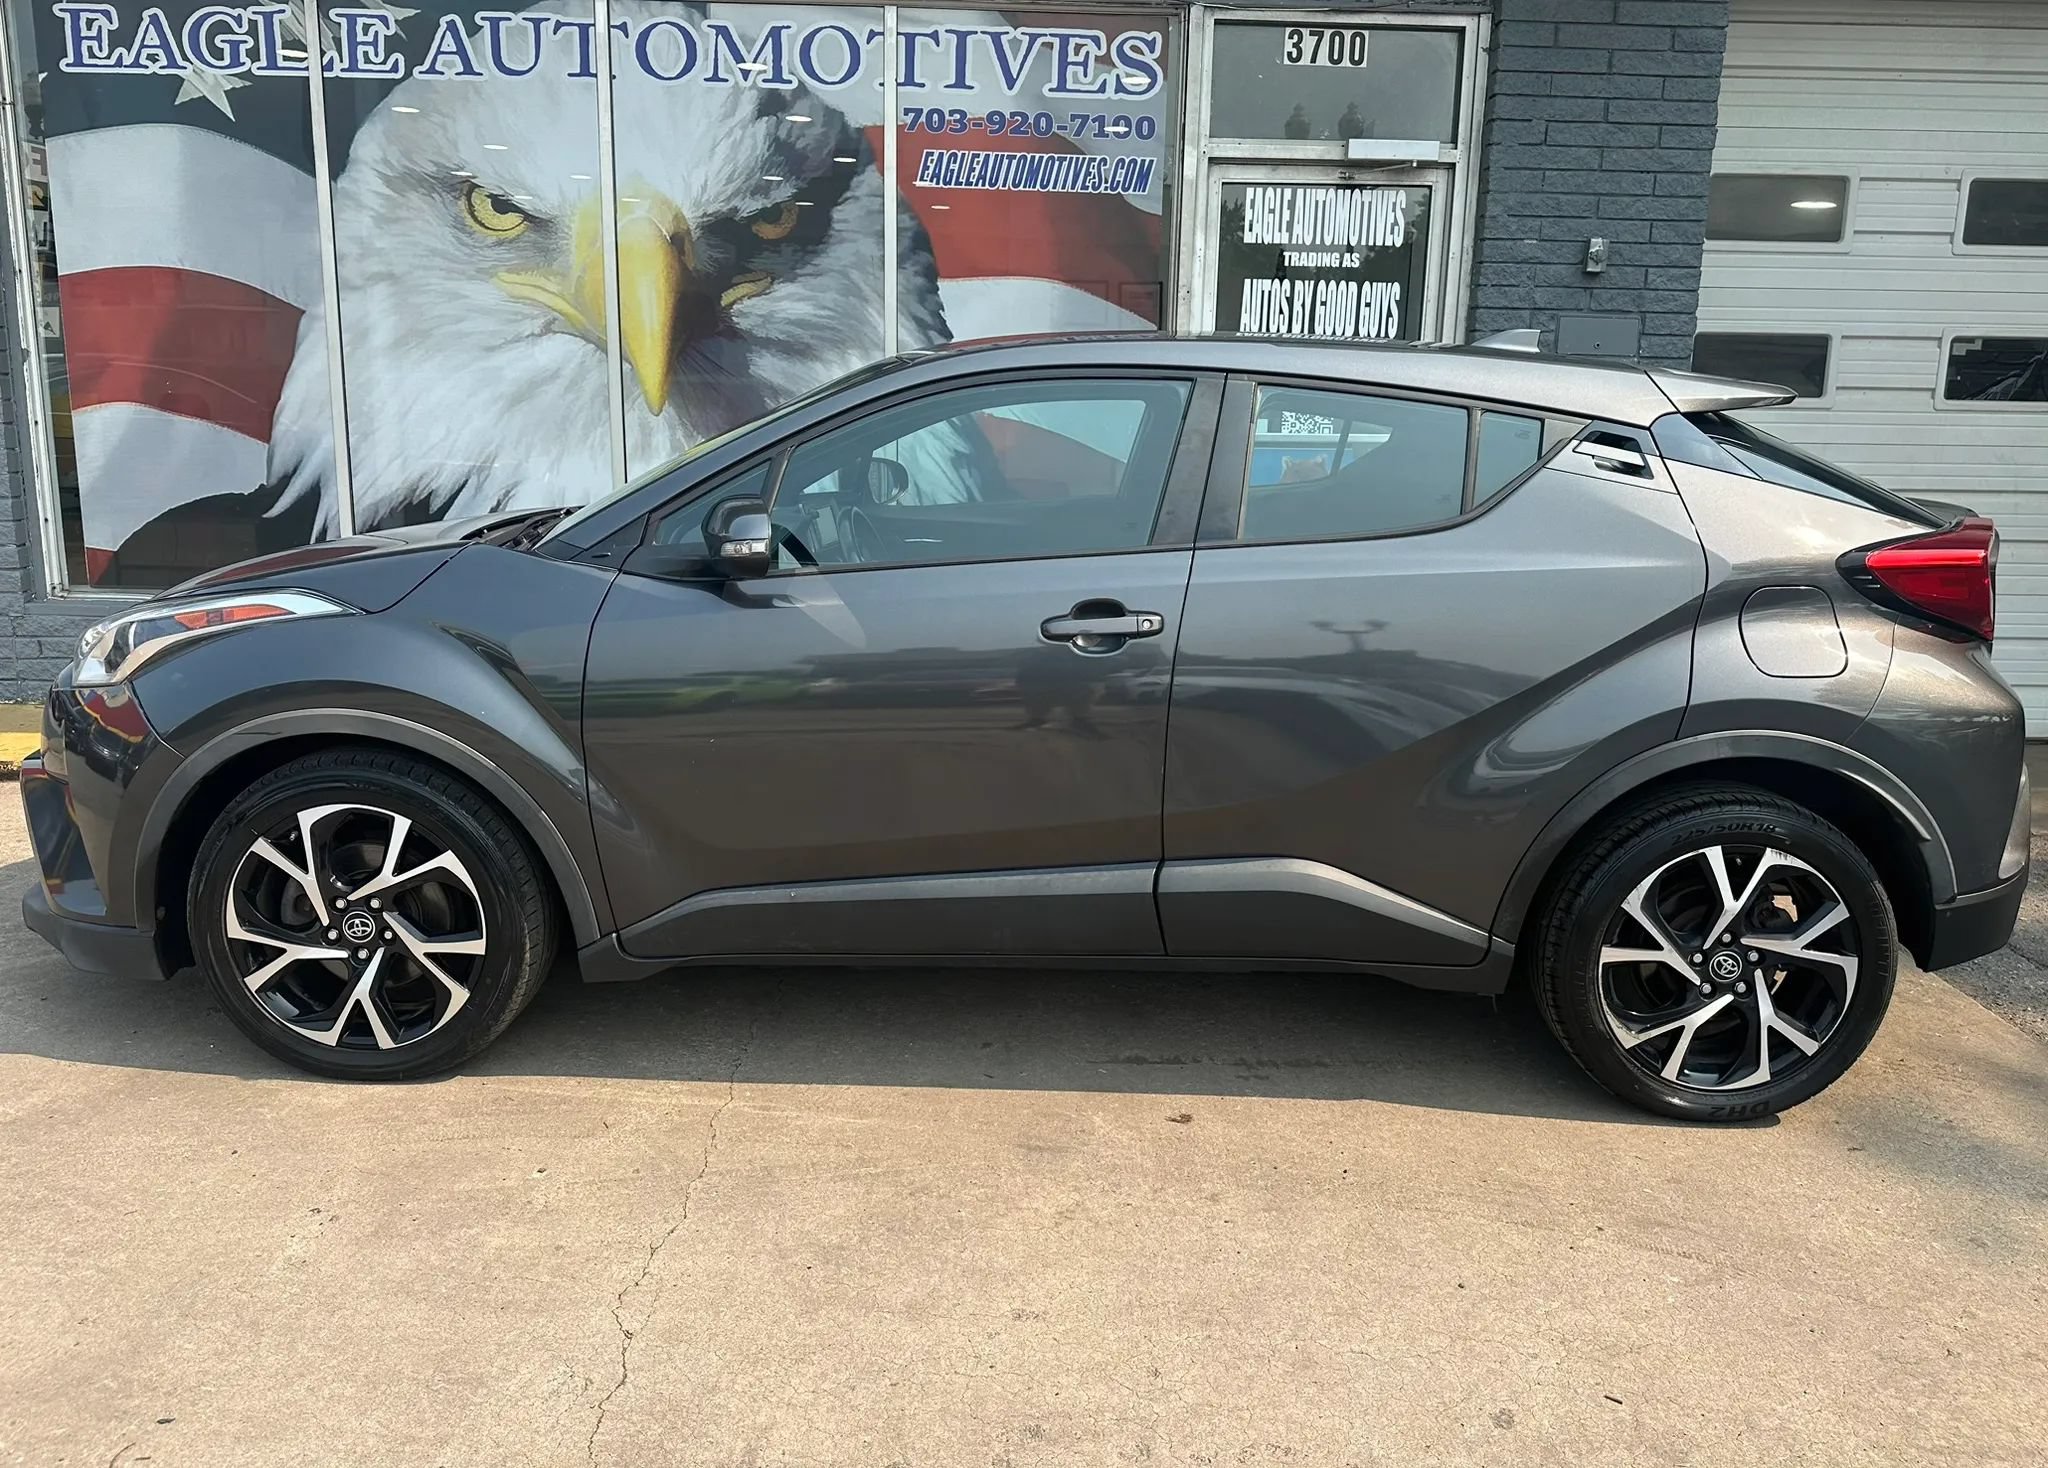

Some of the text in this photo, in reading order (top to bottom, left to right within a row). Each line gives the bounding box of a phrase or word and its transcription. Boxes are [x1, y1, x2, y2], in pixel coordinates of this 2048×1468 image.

[54, 5, 1164, 101] EAGLE AUTOMOTIVES
[1285, 28, 1366, 66] 3700
[903, 107, 1156, 140] 703-920-7100
[917, 149, 1156, 185] EAGLEAUTOMOTIVES.COM
[1244, 187, 1406, 247] EAGLE AUTOMOTIVES
[1284, 252, 1360, 267] TRADING AS
[1240, 278, 1401, 339] AUTOS BY GOOD GUYS
